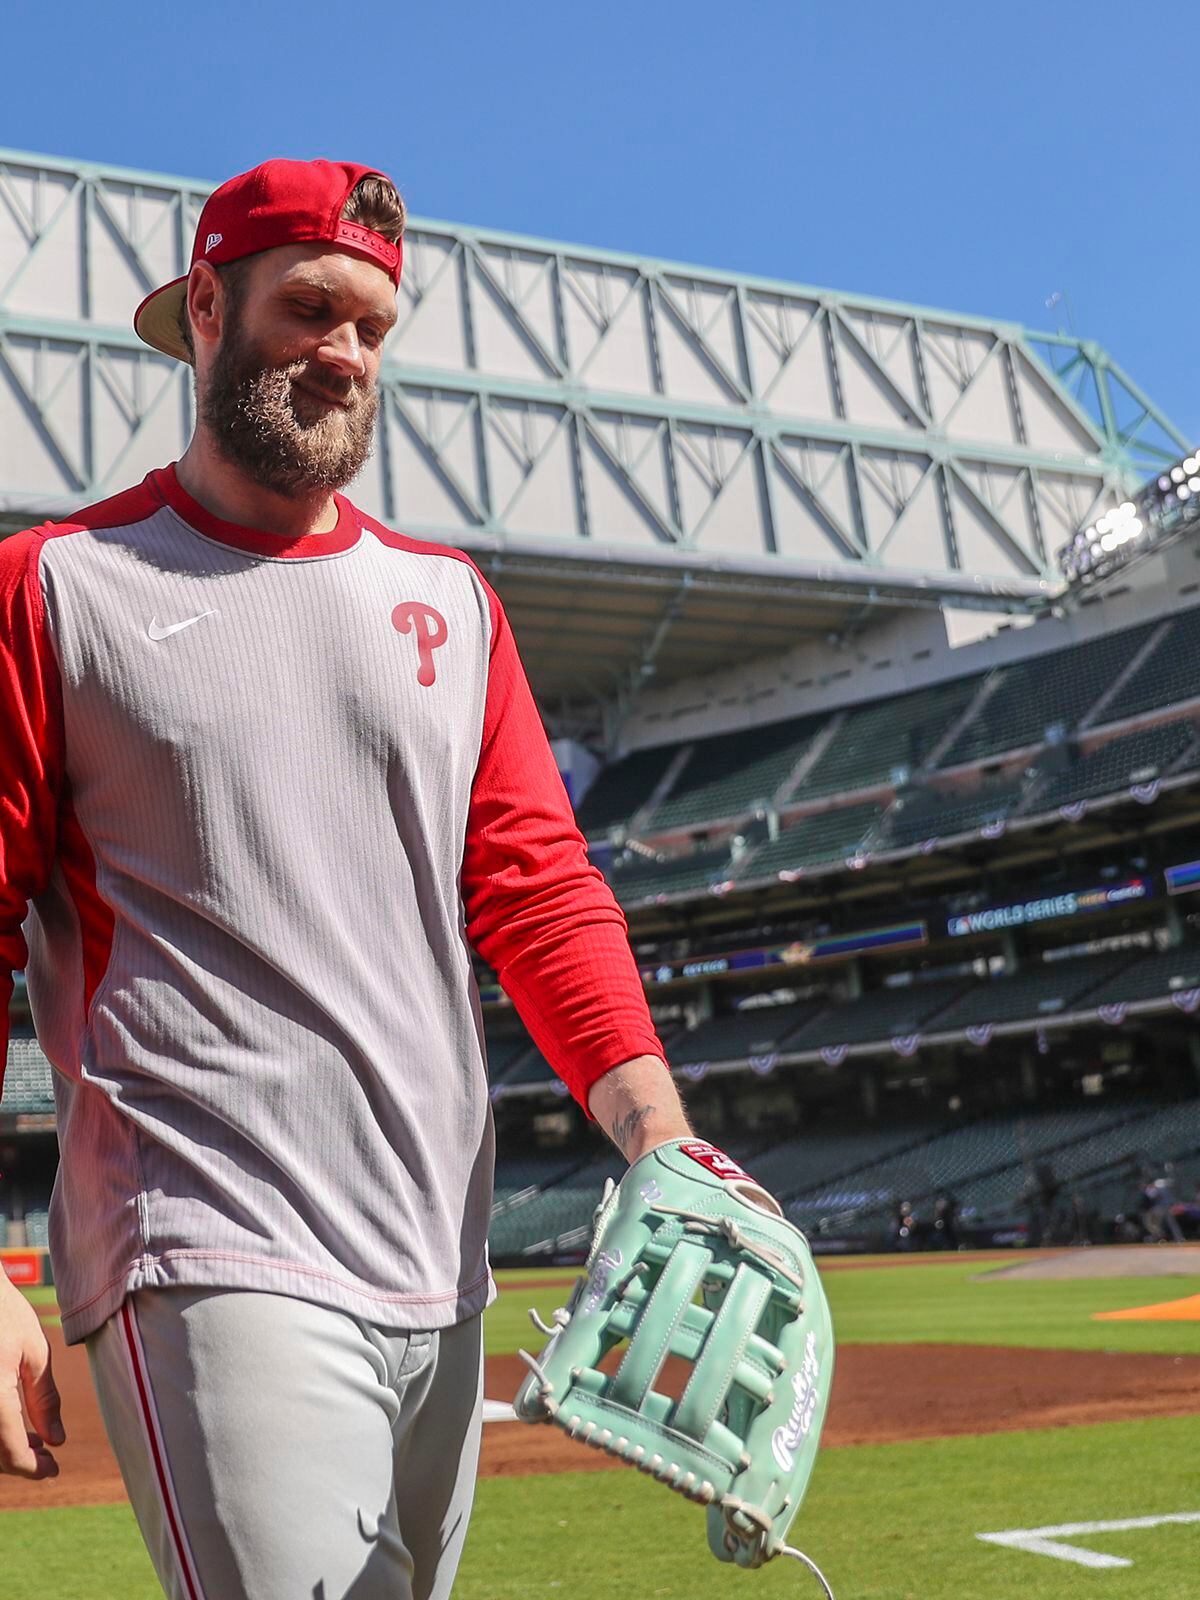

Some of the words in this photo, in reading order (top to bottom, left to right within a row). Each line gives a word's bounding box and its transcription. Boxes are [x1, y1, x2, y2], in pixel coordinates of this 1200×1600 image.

[391, 601, 448, 687] P
[969, 904, 1026, 934] WORLD
[1023, 893, 1079, 922] SERIES
